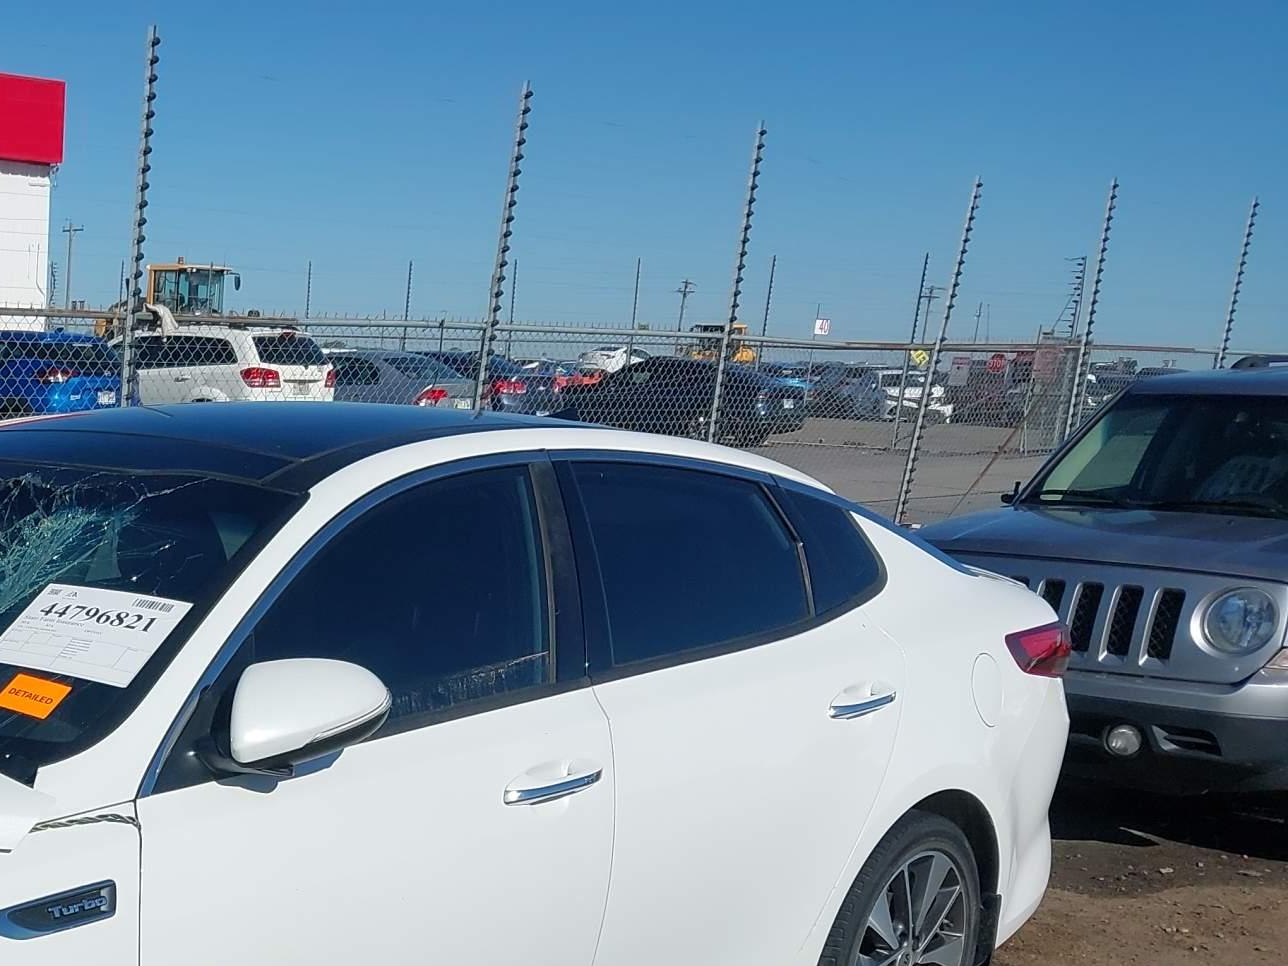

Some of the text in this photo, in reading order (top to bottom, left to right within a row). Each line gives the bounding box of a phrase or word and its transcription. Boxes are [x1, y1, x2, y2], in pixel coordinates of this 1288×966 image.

[40, 602, 160, 633] 44796821
[8, 687, 53, 705] DETAILED
[48, 896, 107, 918] Turbo
